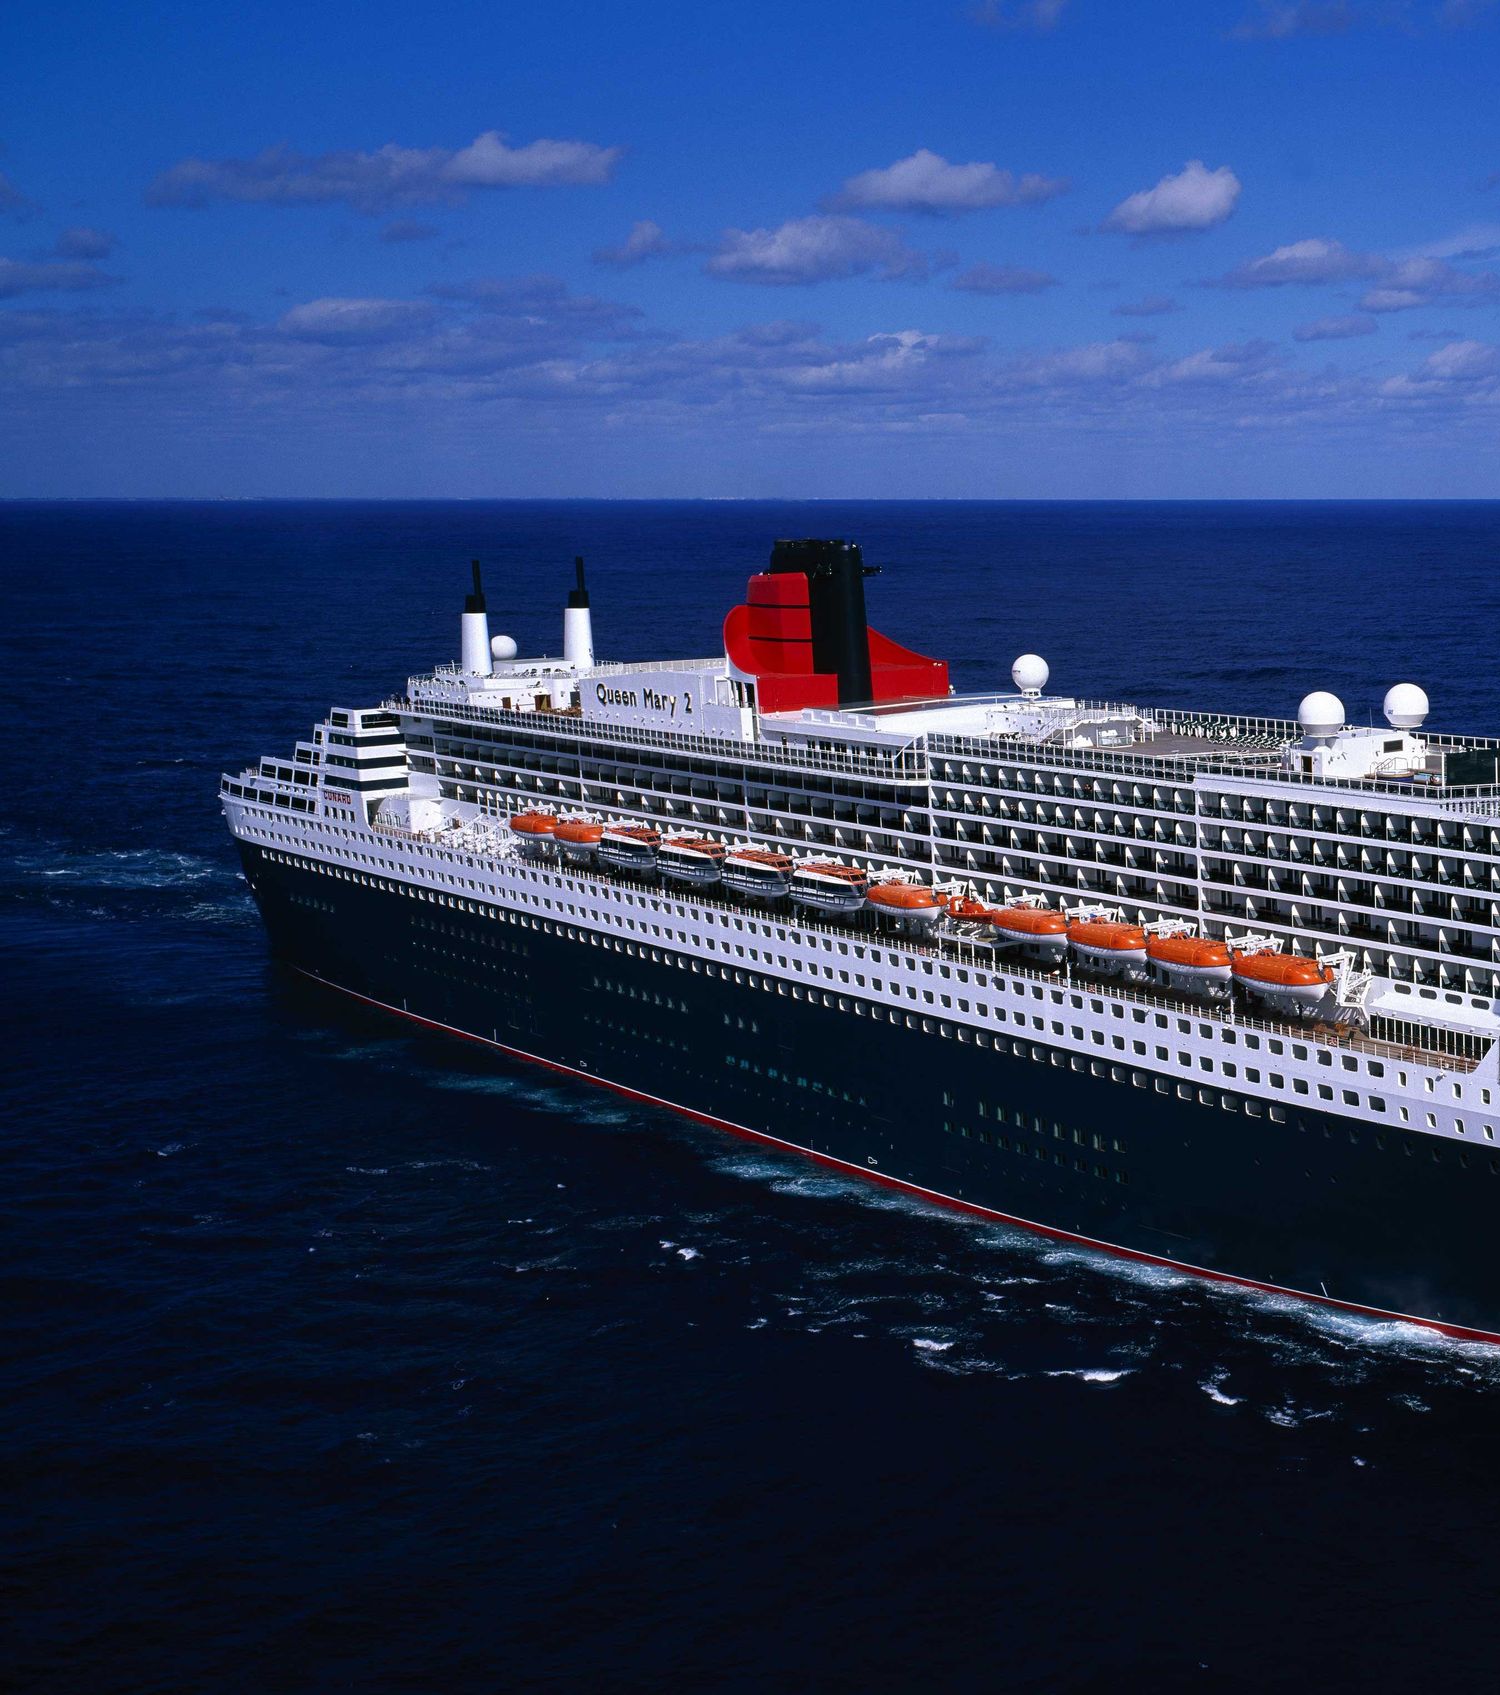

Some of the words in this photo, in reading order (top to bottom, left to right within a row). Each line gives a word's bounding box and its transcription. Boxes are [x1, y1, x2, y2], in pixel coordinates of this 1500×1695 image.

[596, 683, 637, 707] Queen
[643, 687, 677, 717] Mary
[684, 692, 693, 714] 2
[323, 790, 352, 805] CUNARD
